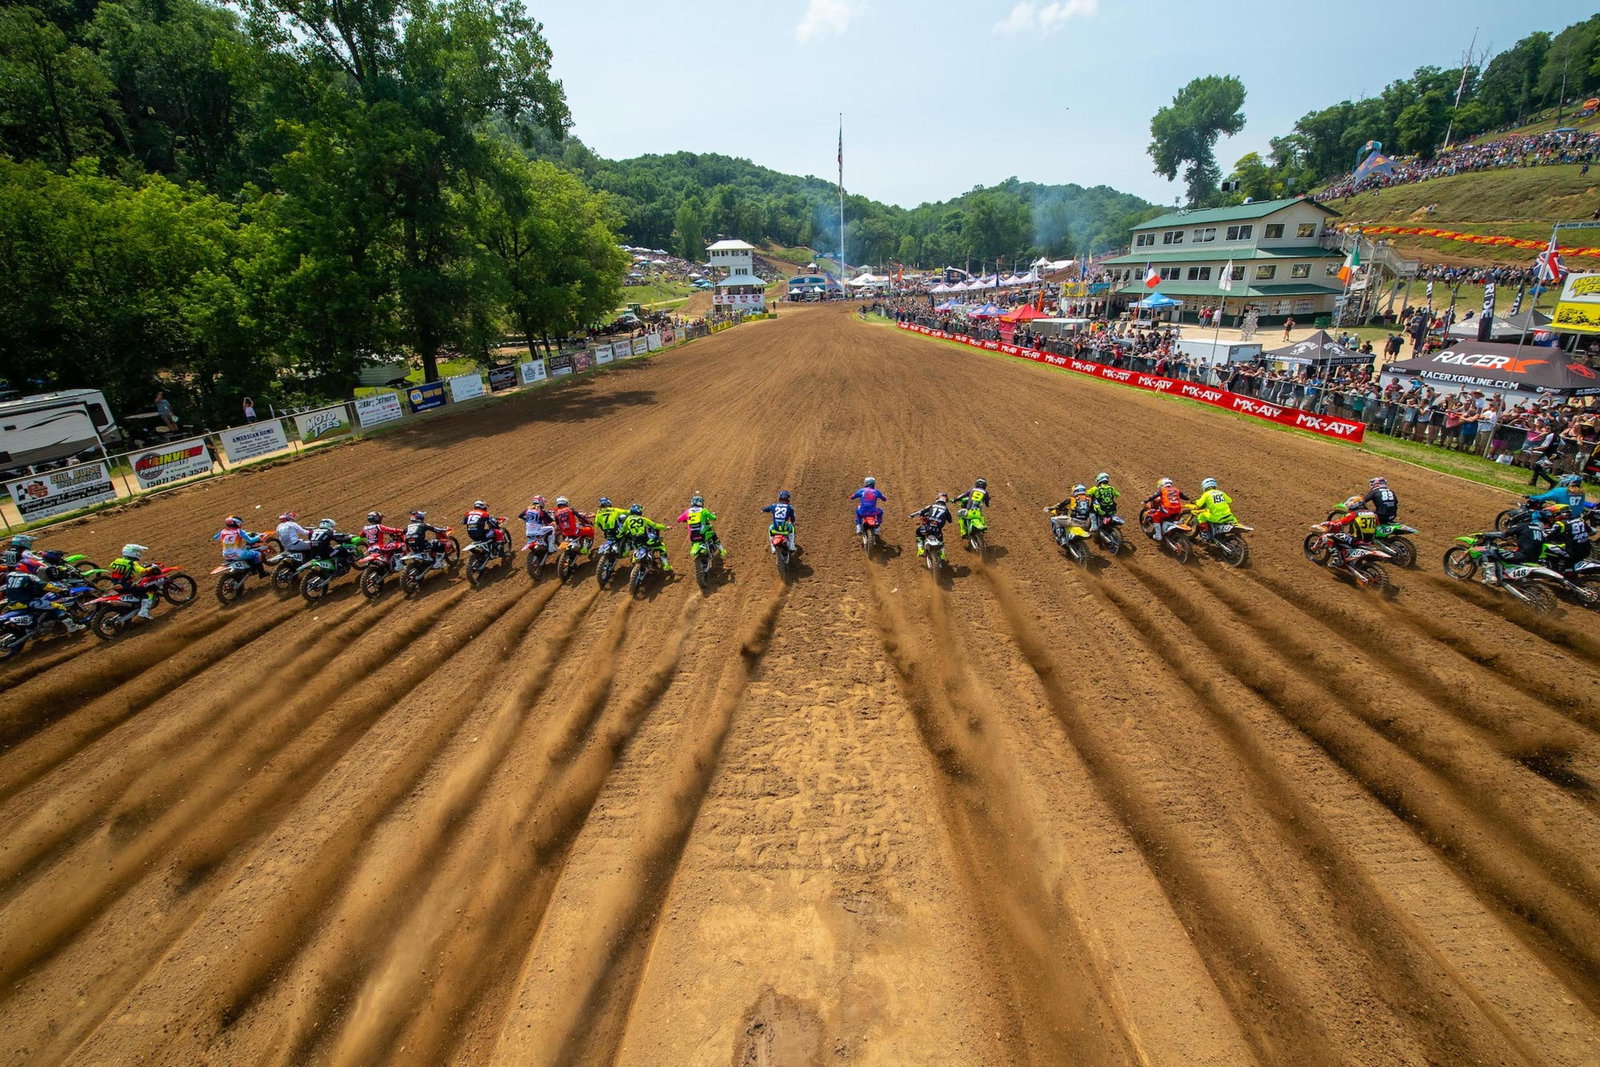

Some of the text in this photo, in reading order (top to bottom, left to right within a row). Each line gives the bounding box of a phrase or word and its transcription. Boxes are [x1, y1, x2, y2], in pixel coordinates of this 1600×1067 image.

[1569, 276, 1600, 292] MOT
[1574, 283, 1600, 298] TEE
[1482, 283, 1495, 318] RIDE
[1420, 370, 1519, 390] RACERXONLINE.COM
[305, 411, 337, 432] MOTO
[312, 419, 341, 438] TEES
[232, 432, 259, 443] AMERICAN
[50, 464, 102, 485] BILL BUNE
[1569, 496, 1582, 506] 87
[603, 513, 610, 524] 7
[774, 507, 788, 519] 23
[931, 507, 945, 518] 17
[466, 514, 481, 525] 15
[629, 518, 644, 528] 29
[1512, 569, 1527, 578] 148
